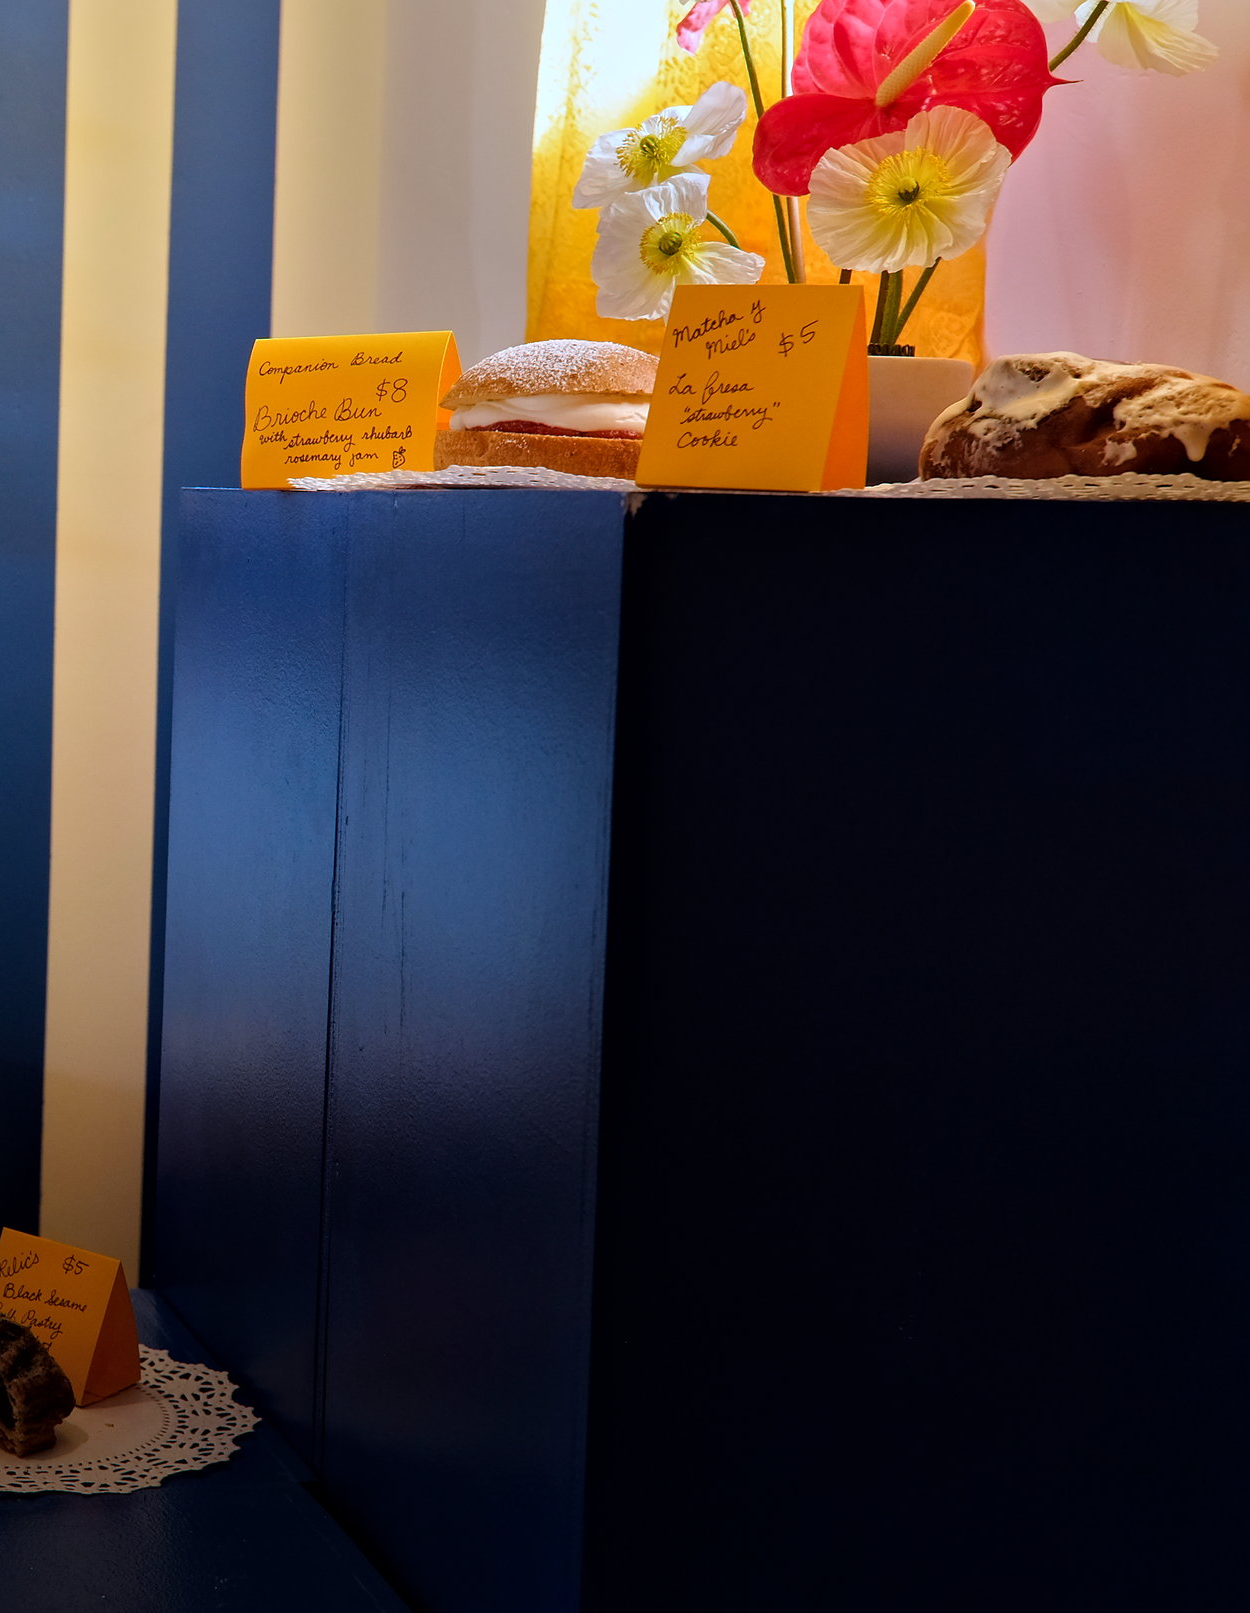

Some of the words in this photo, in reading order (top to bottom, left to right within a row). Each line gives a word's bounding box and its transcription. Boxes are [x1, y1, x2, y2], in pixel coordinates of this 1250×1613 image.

[673, 310, 743, 347] Matcha
[778, 320, 818, 357] $5
[706, 329, 755, 359] Miel's
[259, 359, 339, 384] Companion
[350, 352, 403, 366] Bread
[376, 379, 408, 403] $8
[669, 374, 695, 395] La
[253, 400, 327, 432] Brioche
[334, 398, 382, 421] Bun
[259, 431, 287, 445] with
[677, 430, 738, 448] Cookie
[284, 453, 342, 470] rosemary
[349, 452, 378, 467] jam
[62, 1254, 89, 1275] $5
[3, 1283, 42, 1301] Black
[45, 1290, 88, 1312] Sesame
